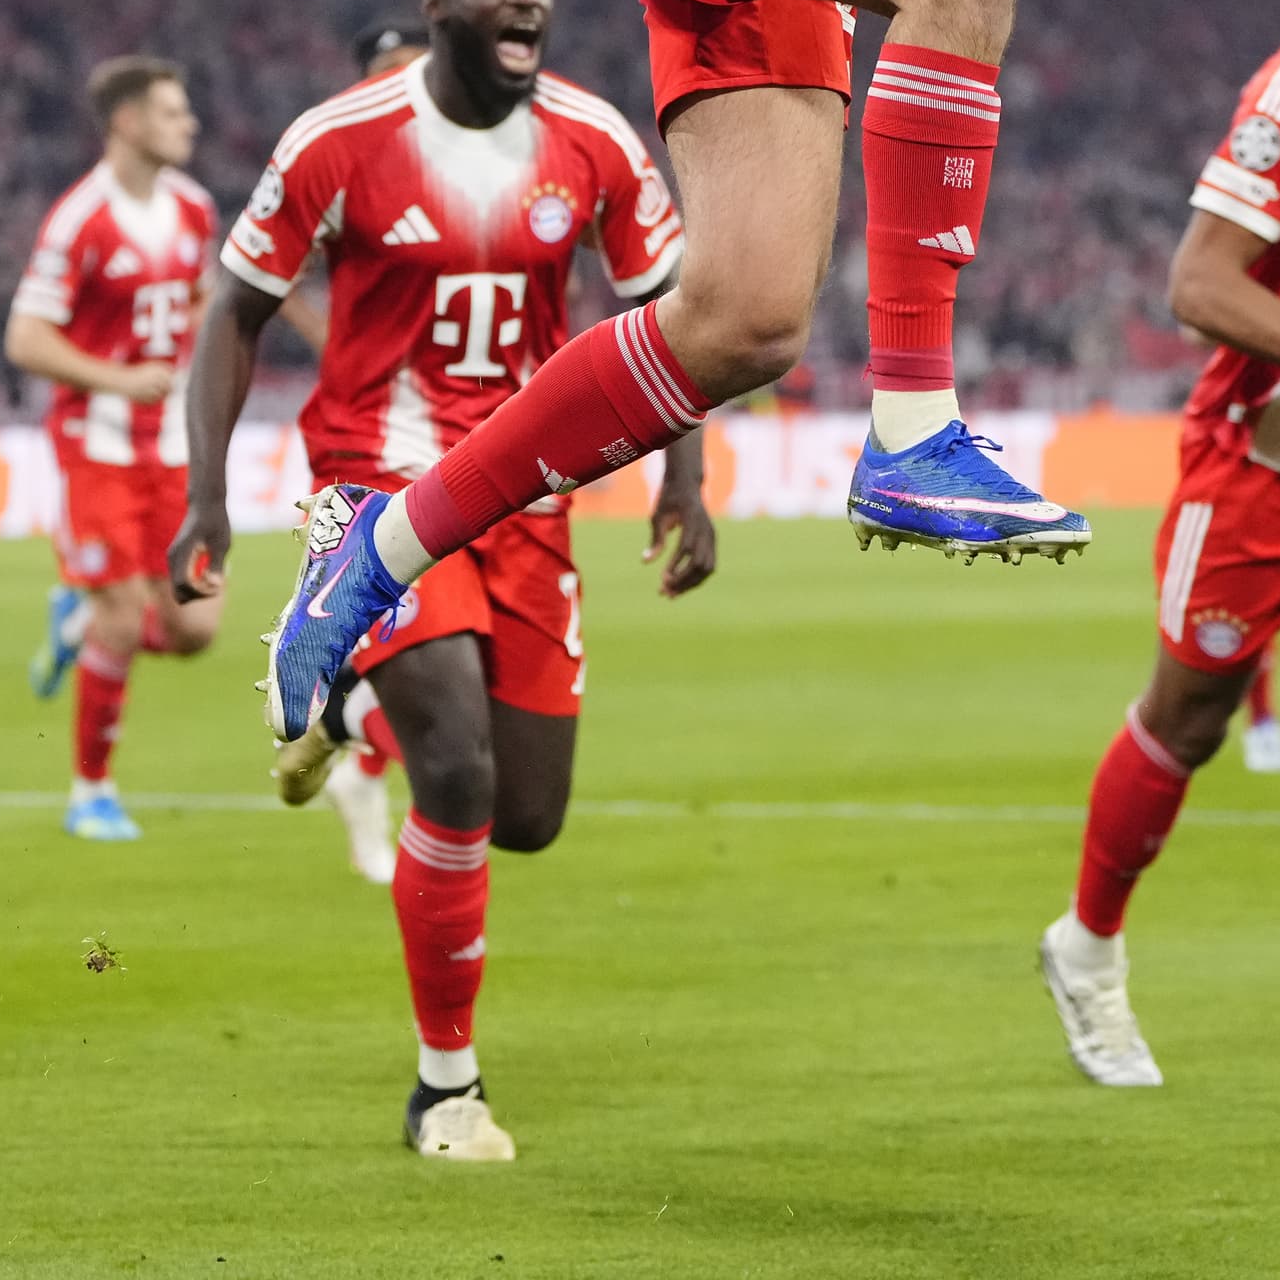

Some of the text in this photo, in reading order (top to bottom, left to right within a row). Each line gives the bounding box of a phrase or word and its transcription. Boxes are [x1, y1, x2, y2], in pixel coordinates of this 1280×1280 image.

[944, 156, 975, 168] MIA
[943, 166, 973, 179] SAN
[942, 175, 972, 189] MIA
